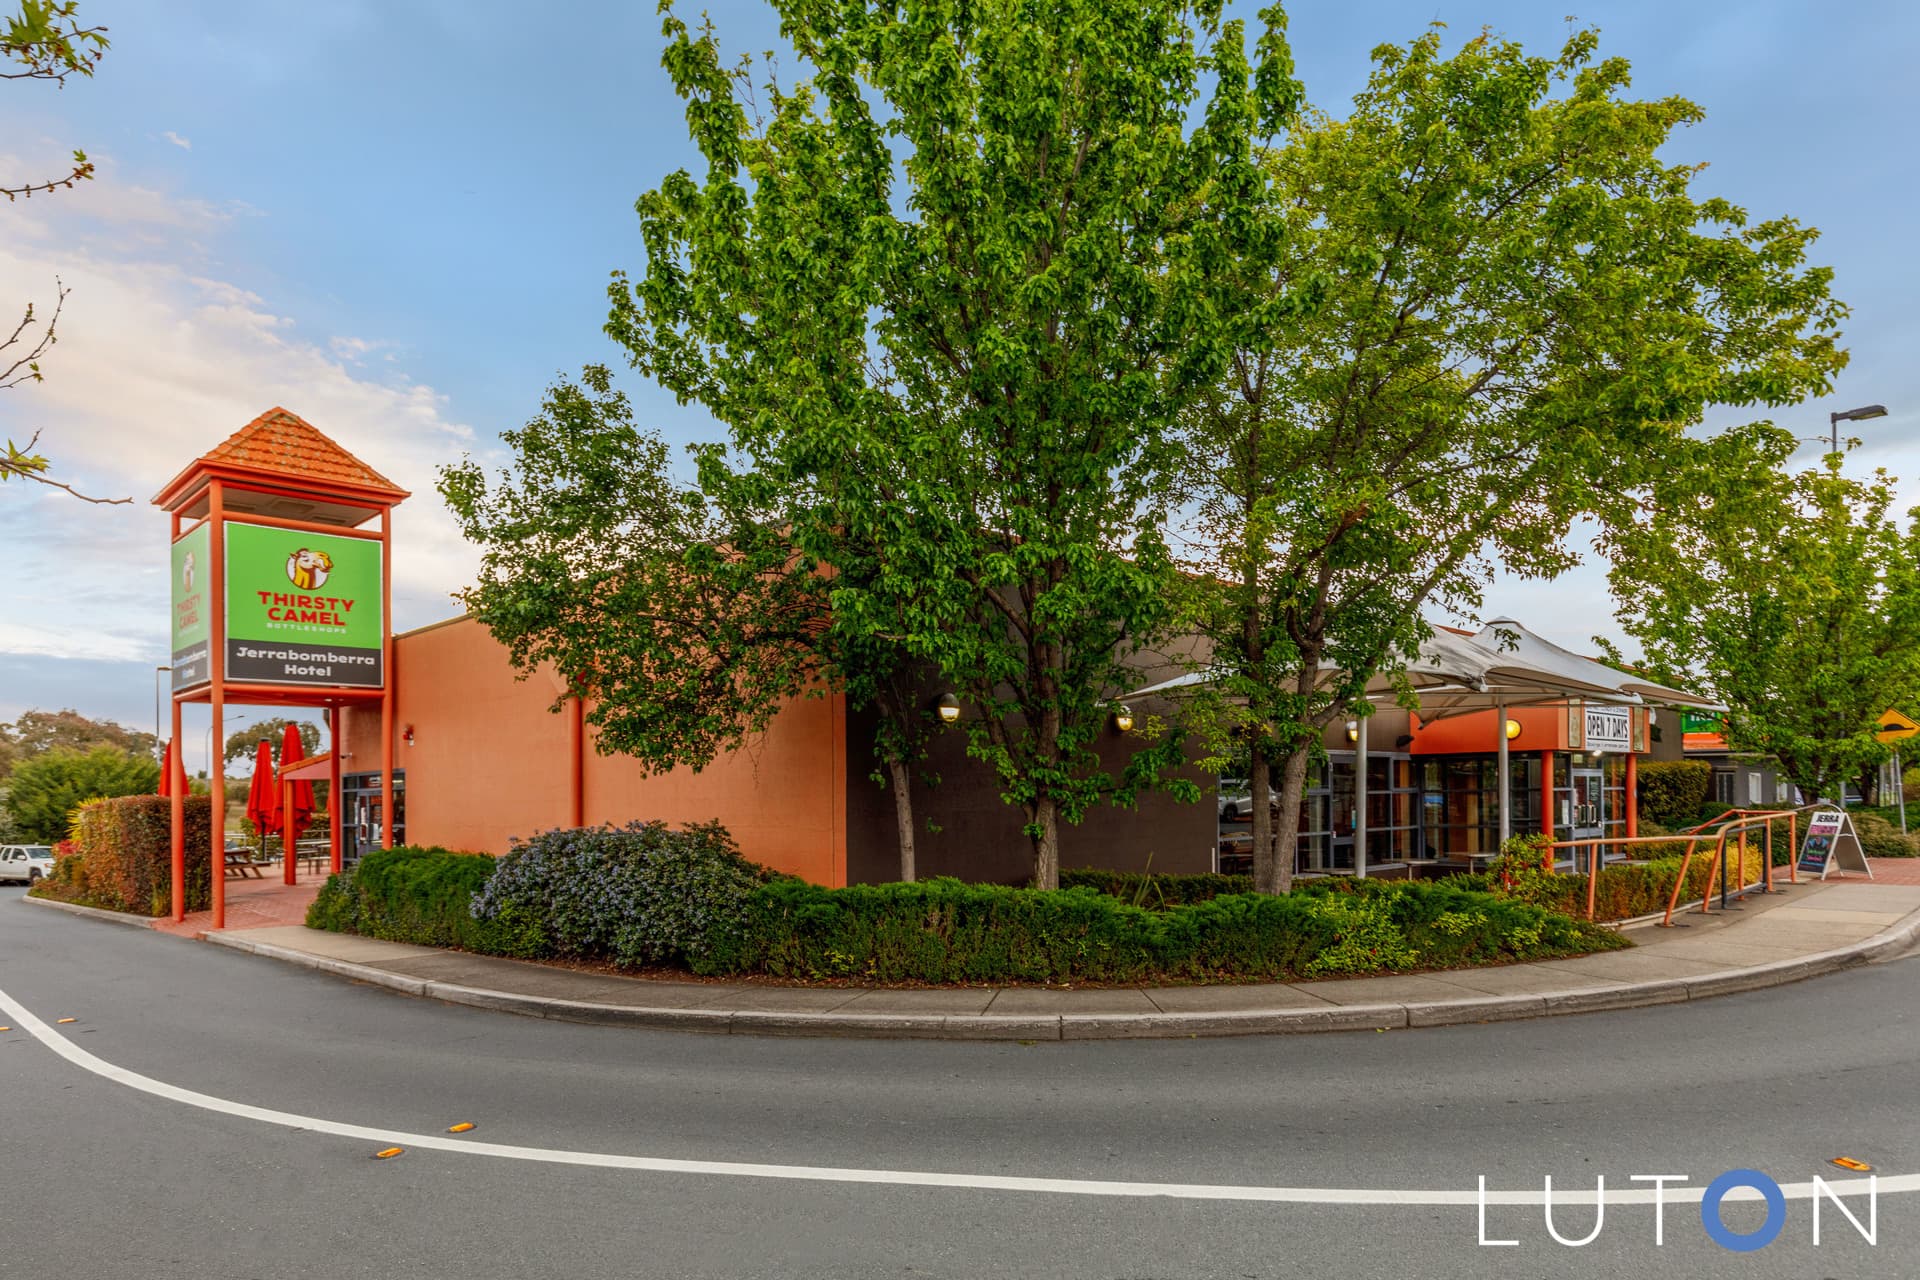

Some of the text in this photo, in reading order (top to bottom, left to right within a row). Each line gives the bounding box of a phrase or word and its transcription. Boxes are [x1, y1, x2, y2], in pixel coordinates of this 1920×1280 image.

[257, 591, 354, 612] THIRSTY
[268, 607, 346, 626] CAMEL
[266, 623, 347, 634] BOTTLESHOPS
[236, 647, 375, 665] Jerrabomberra
[284, 664, 332, 677] Hotel
[1588, 715, 1628, 739] OPEN 7 DAYS
